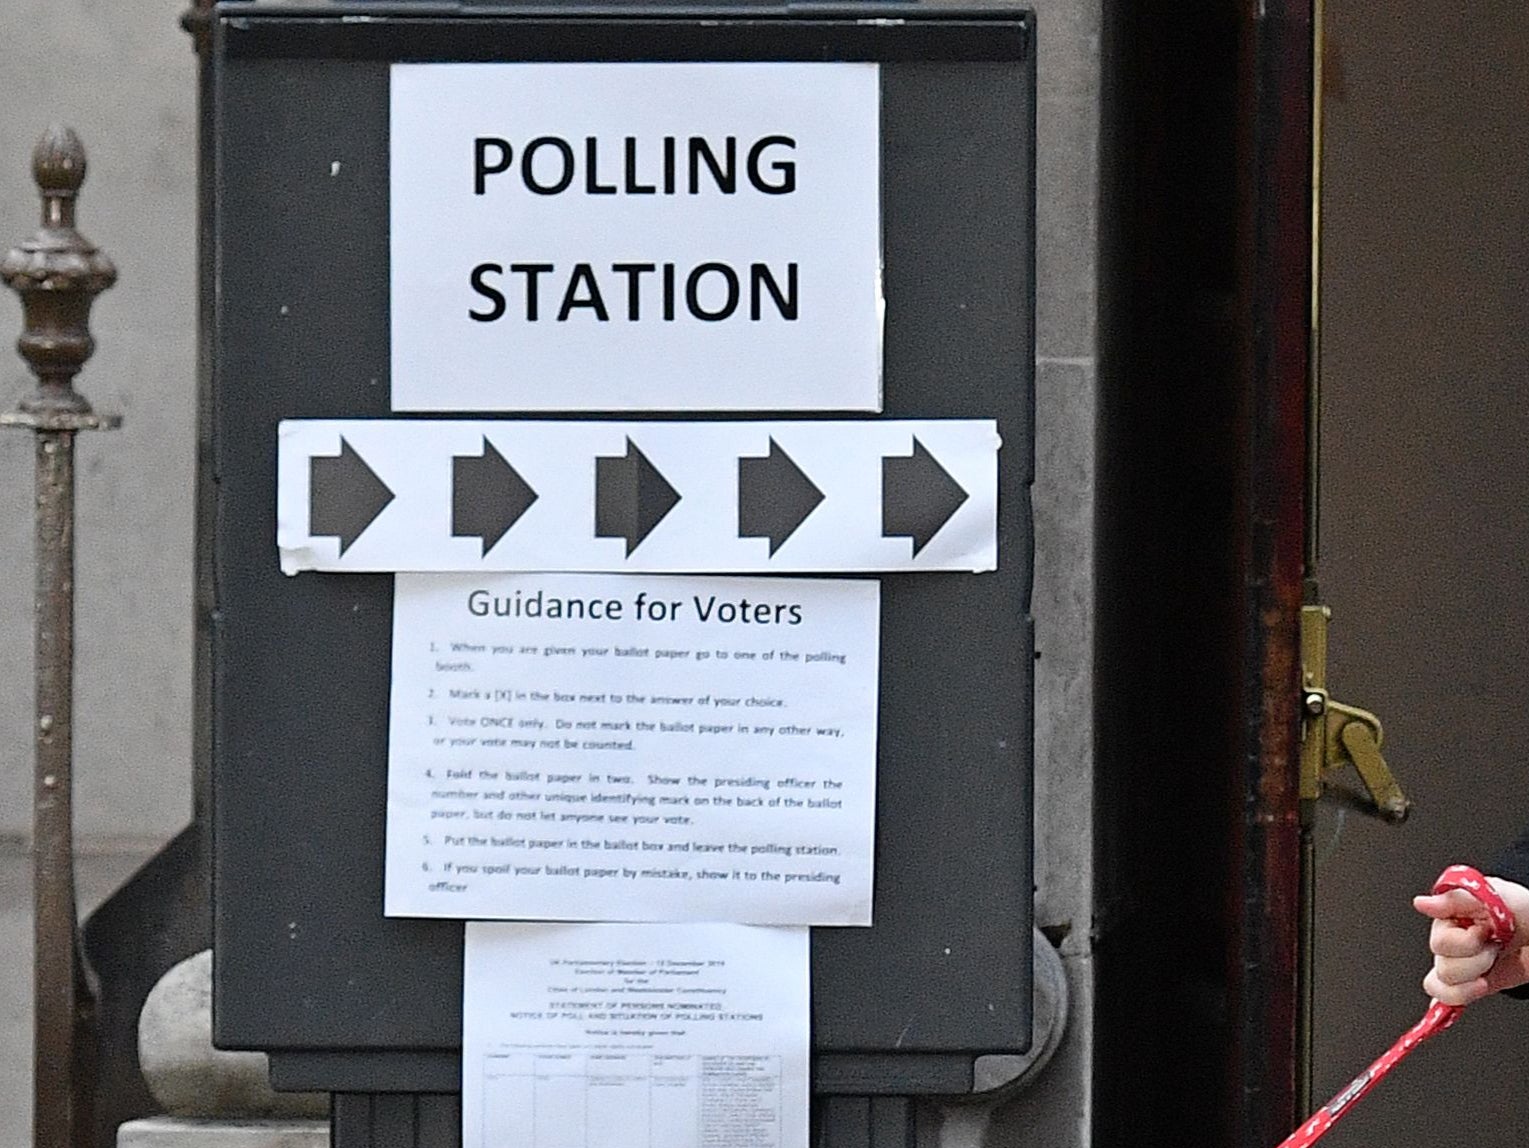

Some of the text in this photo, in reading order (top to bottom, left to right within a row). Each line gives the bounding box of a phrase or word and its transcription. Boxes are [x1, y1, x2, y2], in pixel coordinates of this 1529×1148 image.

[473, 134, 798, 196] POLLING
[467, 261, 800, 323] STATION
[467, 589, 803, 626] Guidance for Voters
[450, 643, 485, 652] When
[492, 646, 513, 654] you
[519, 646, 538, 654] are
[543, 646, 576, 657] given
[581, 647, 609, 657] your
[615, 648, 649, 657] ballot
[655, 649, 689, 660] paper
[696, 650, 710, 660] go
[716, 649, 728, 659] to
[734, 651, 756, 660] one
[762, 650, 775, 660] of
[780, 650, 799, 660] the
[805, 652, 846, 665] polling
[449, 690, 480, 699] Mark
[515, 691, 527, 699] in
[530, 691, 550, 701] the
[554, 692, 576, 702] box
[579, 694, 606, 703] next
[610, 694, 622, 703] to
[626, 694, 645, 703] the
[650, 696, 693, 705] answer
[698, 696, 710, 705] of
[714, 698, 741, 708] your
[745, 697, 787, 708] choice.
[480, 717, 513, 728] ONCE
[556, 719, 572, 729] Do
[576, 720, 597, 729] not
[600, 719, 631, 730] mark
[636, 722, 656, 731] the
[660, 722, 694, 732] ballot
[698, 724, 733, 735] paper
[737, 723, 749, 733] in
[753, 725, 774, 736] any
[779, 725, 811, 735] other
[816, 726, 845, 738] way.
[433, 737, 446, 745] or
[450, 738, 477, 747] your
[481, 738, 507, 747] vote
[511, 739, 536, 750] may
[540, 739, 560, 748] not
[564, 739, 578, 748] be
[446, 770, 472, 779] Fold
[479, 771, 499, 780] the
[505, 771, 540, 781] ballot
[547, 773, 581, 784] paper
[589, 773, 600, 782] in
[607, 774, 634, 784] two.
[648, 774, 681, 785] Show
[688, 776, 707, 785] the
[714, 776, 770, 790] presiding
[823, 779, 842, 789] the
[431, 789, 842, 809] number and other unique identifying mark on the back of the ballot
[473, 810, 493, 819] but
[497, 811, 512, 820] do
[516, 811, 536, 820] not
[540, 811, 555, 820] let
[560, 814, 604, 823] anyone
[633, 816, 659, 825] your
[664, 816, 694, 825] vote.
[444, 835, 464, 845] Put
[468, 836, 488, 846] the
[491, 837, 525, 847] ballot
[529, 839, 563, 849] paper
[567, 839, 577, 848] in
[581, 839, 600, 849] the
[604, 840, 638, 850] ballot
[642, 842, 664, 852] box
[668, 843, 689, 852] and
[693, 843, 724, 853] leave
[728, 843, 747, 853] the
[751, 844, 791, 856] polling
[444, 863, 452, 872] If
[456, 865, 478, 875] you
[514, 866, 541, 875] your
[545, 866, 579, 876] ballot
[584, 867, 618, 878] paper
[623, 868, 636, 879] by
[641, 869, 693, 880] mistake,
[697, 869, 728, 879] show
[732, 870, 741, 880] it
[745, 871, 757, 880] to
[761, 871, 780, 881] the
[784, 871, 841, 885] presiding
